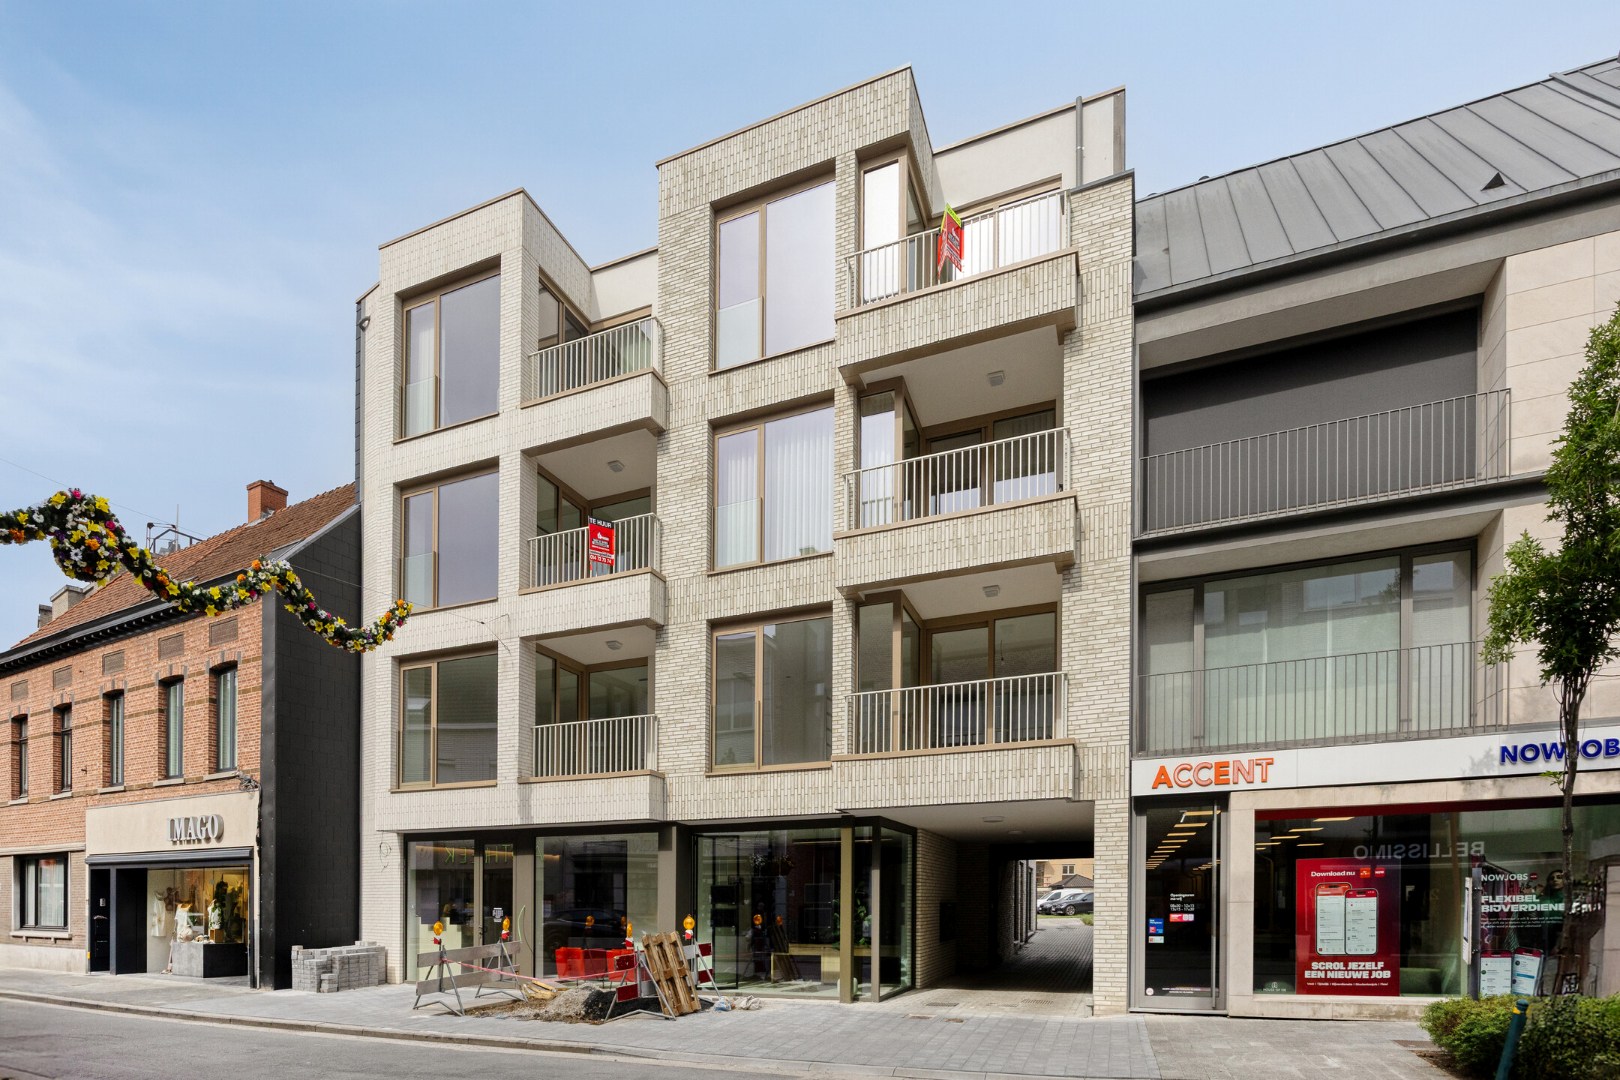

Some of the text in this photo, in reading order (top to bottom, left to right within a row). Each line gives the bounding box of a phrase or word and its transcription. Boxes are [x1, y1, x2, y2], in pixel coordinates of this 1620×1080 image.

[597, 520, 612, 528] HUUR
[1500, 738, 1620, 765] NOWOB
[1152, 757, 1274, 789] ACCENT
[166, 814, 223, 842] IMAGO
[1481, 873, 1528, 881] NOWJOBS
[1481, 894, 1540, 903] FLEXIBEL
[1481, 902, 1566, 912] BIJVERDIENE
[1311, 961, 1385, 970] SCROL JEZELF
[1304, 970, 1391, 979] EEN NIEUWE JOB
